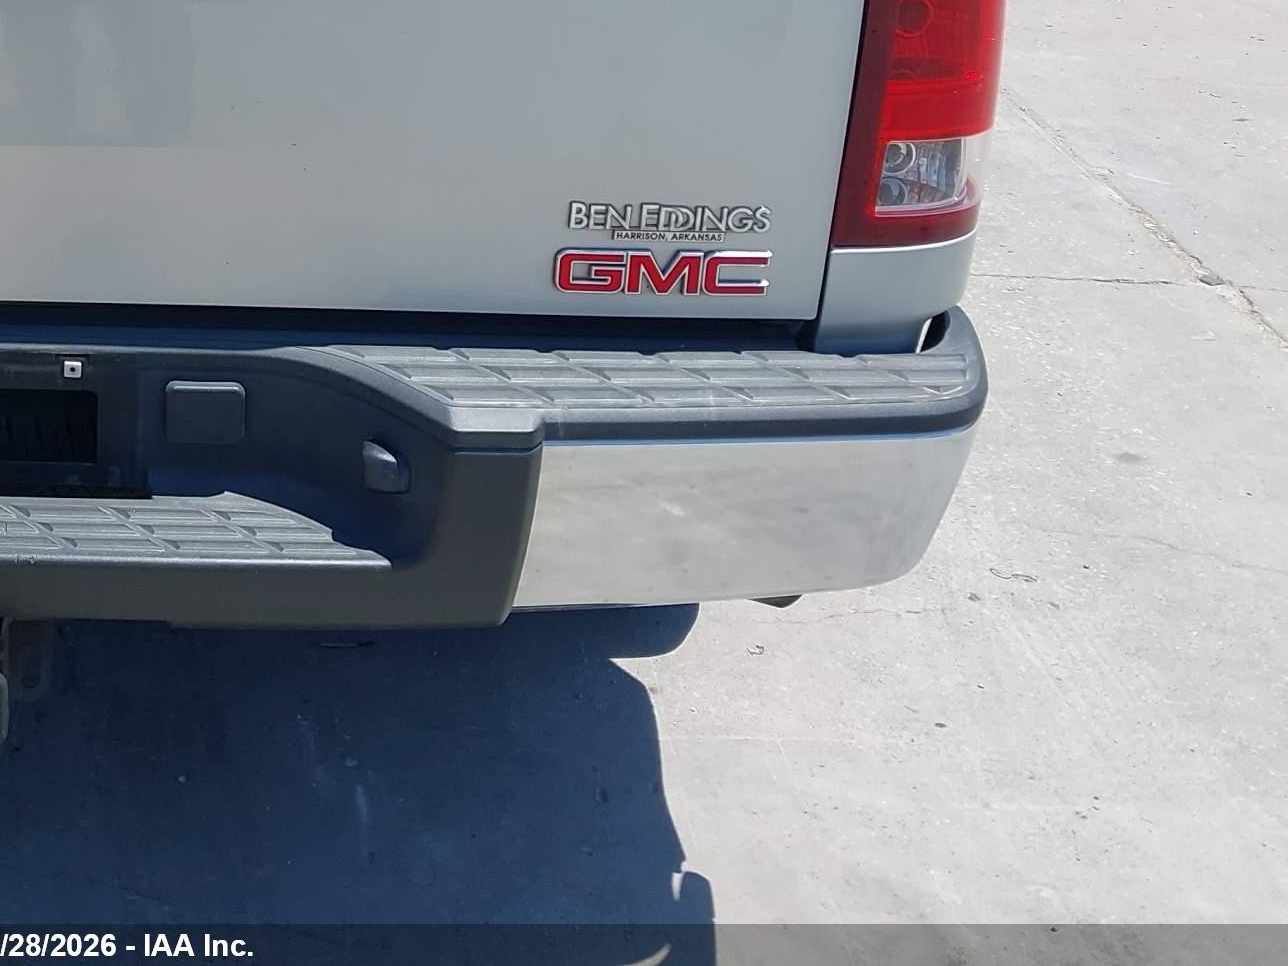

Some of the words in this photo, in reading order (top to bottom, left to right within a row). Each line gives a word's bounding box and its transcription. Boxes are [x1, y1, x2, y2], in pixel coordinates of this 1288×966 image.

[569, 201, 632, 230] BEN
[641, 203, 772, 233] EDDINGS
[616, 232, 669, 241] HARRISON,
[671, 232, 723, 242] ARKANSAS
[553, 247, 773, 296] GMC
